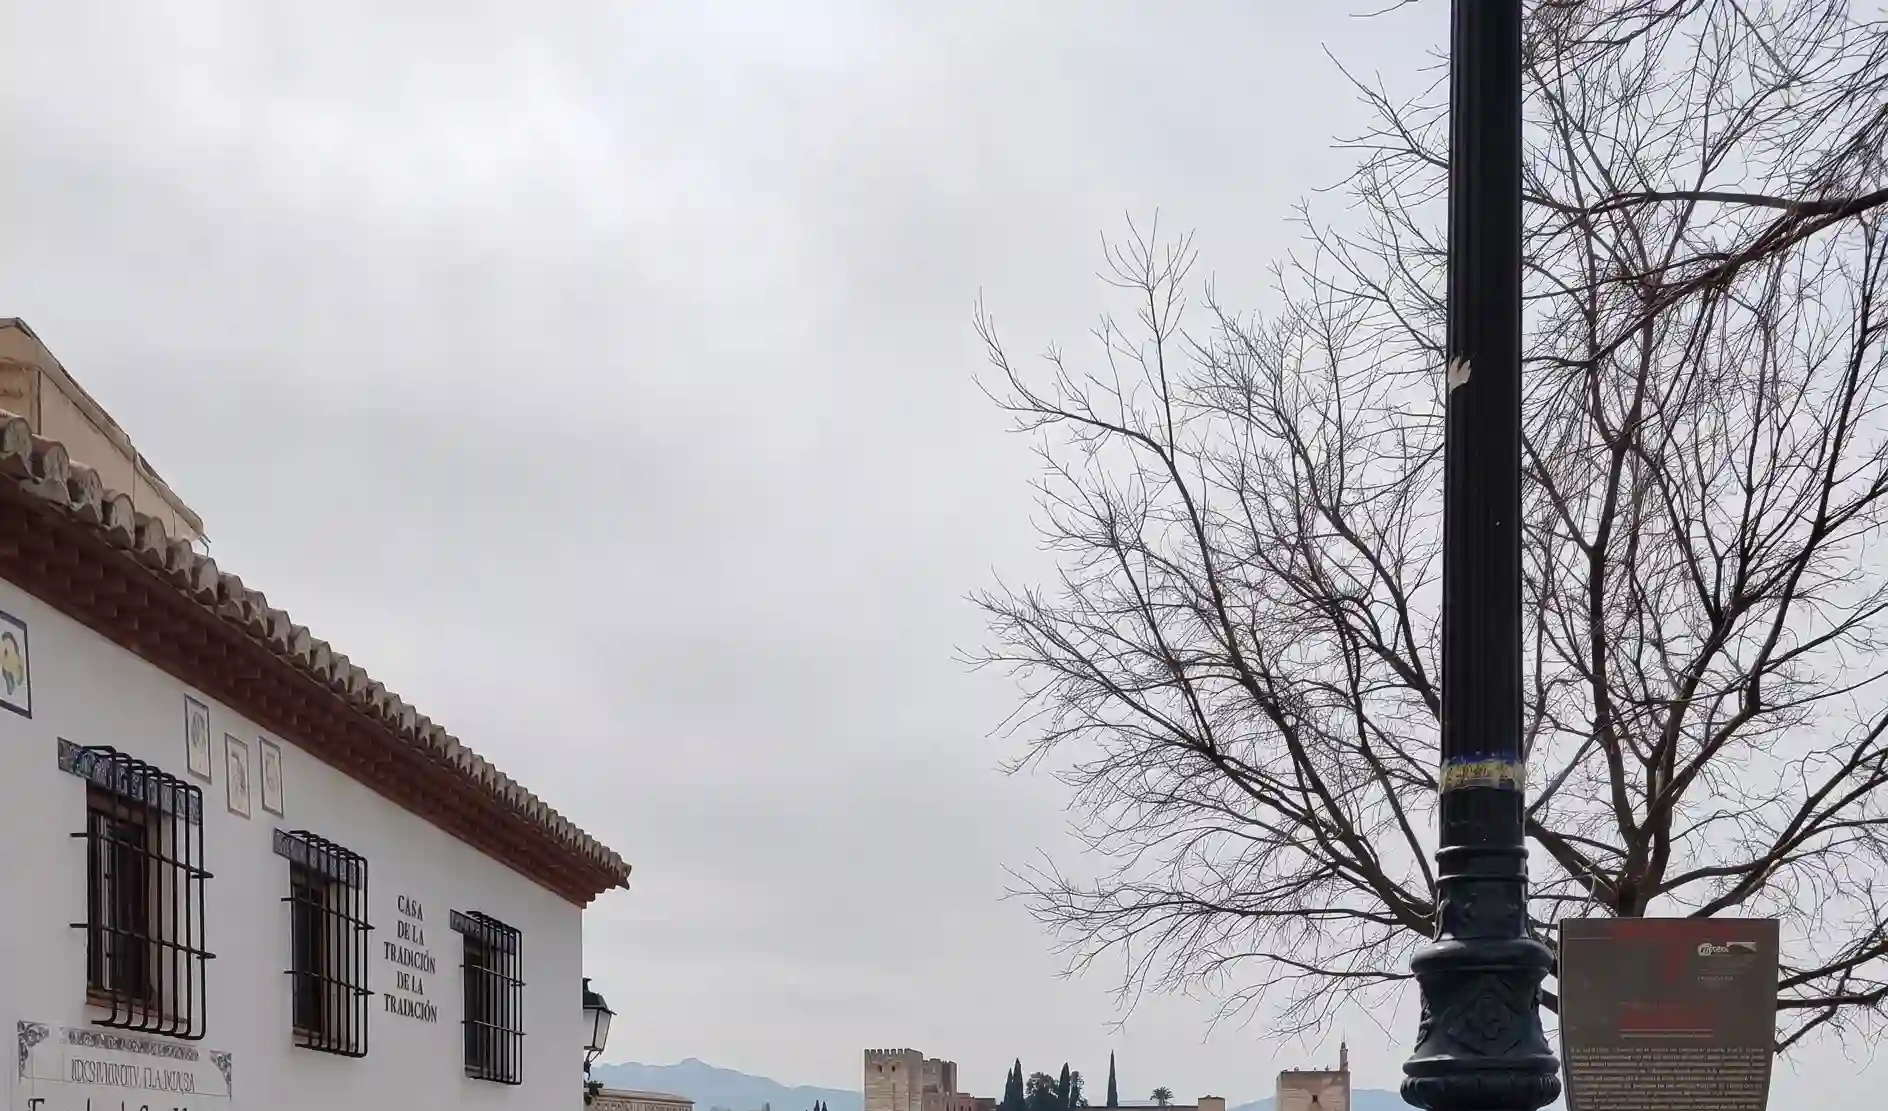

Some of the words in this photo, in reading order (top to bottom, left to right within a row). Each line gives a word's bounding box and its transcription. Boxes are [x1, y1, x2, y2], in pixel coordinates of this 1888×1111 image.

[397, 894, 424, 922] CASA
[397, 920, 410, 941] DE
[412, 924, 424, 946] LA
[383, 941, 436, 974] TRADICIÓN
[396, 970, 410, 991] DE
[411, 974, 424, 995] LA
[383, 993, 438, 1024] TRADICIÓN
